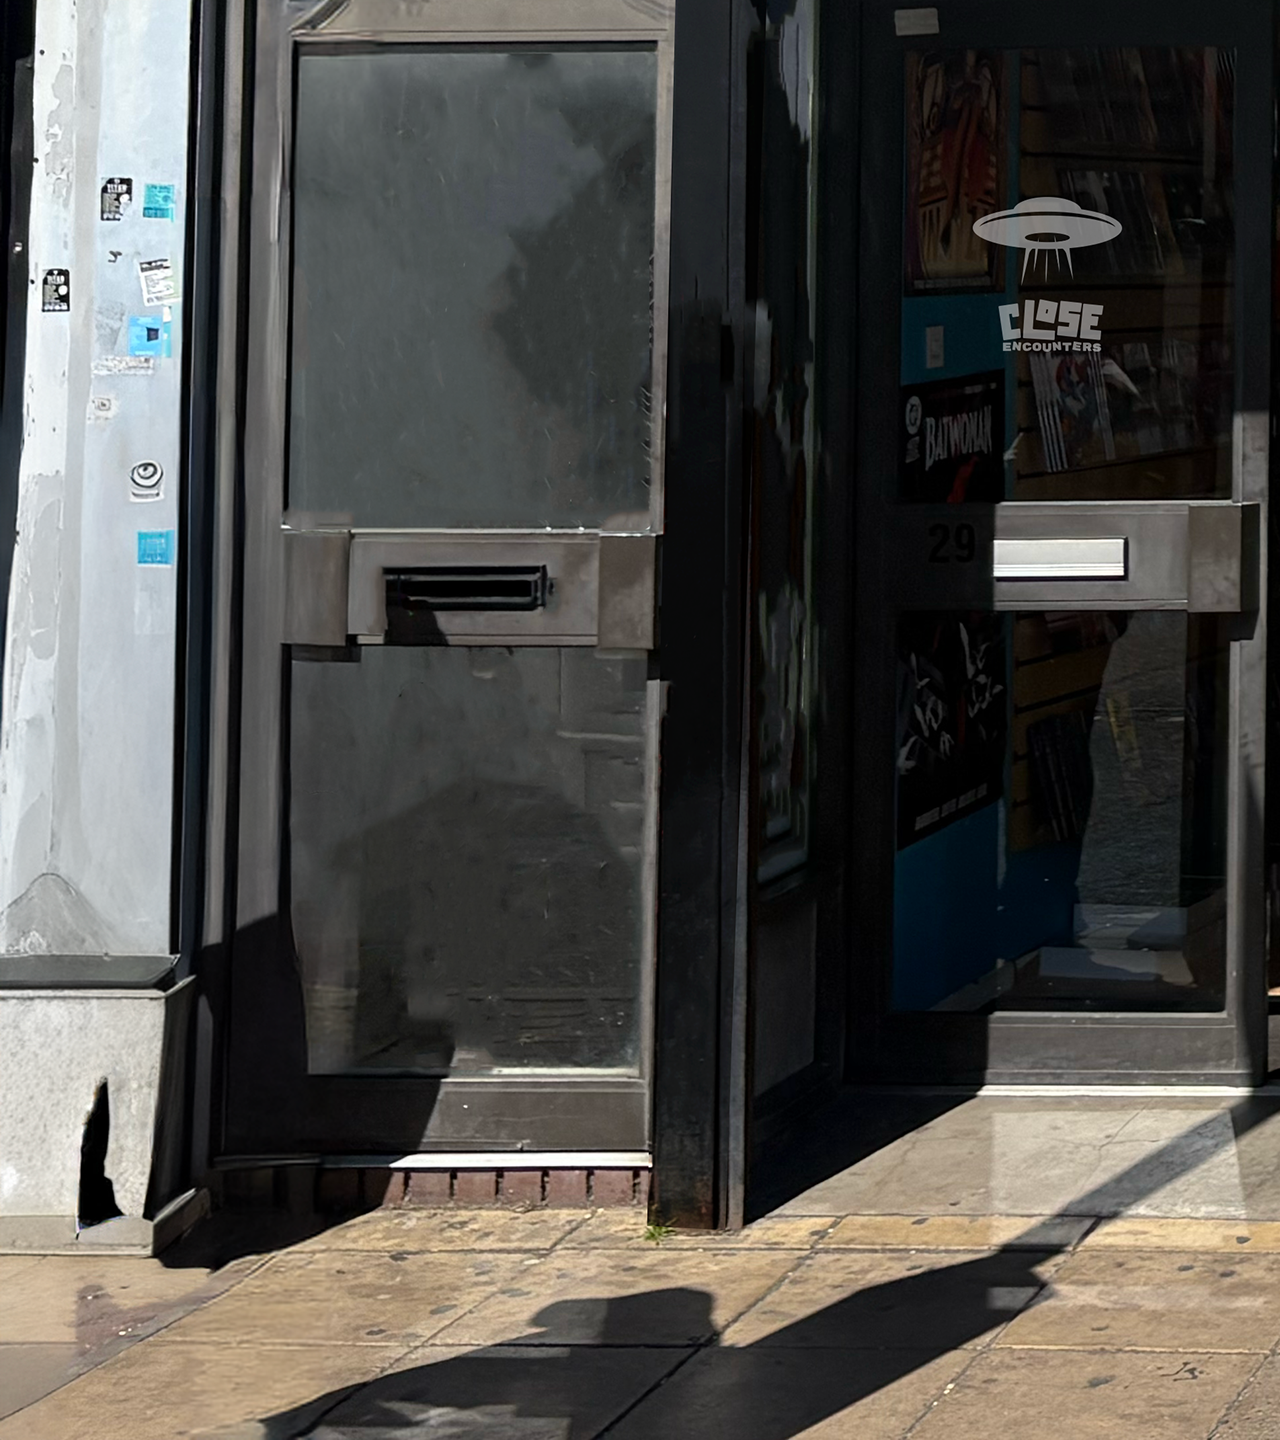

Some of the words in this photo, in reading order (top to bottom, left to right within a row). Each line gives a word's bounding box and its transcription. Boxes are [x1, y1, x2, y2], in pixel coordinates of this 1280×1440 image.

[998, 299, 1104, 341] CLOSE
[1002, 341, 1102, 353] ENCOUNTERS
[925, 404, 992, 472] BATWOMAN
[928, 523, 975, 563] 29
